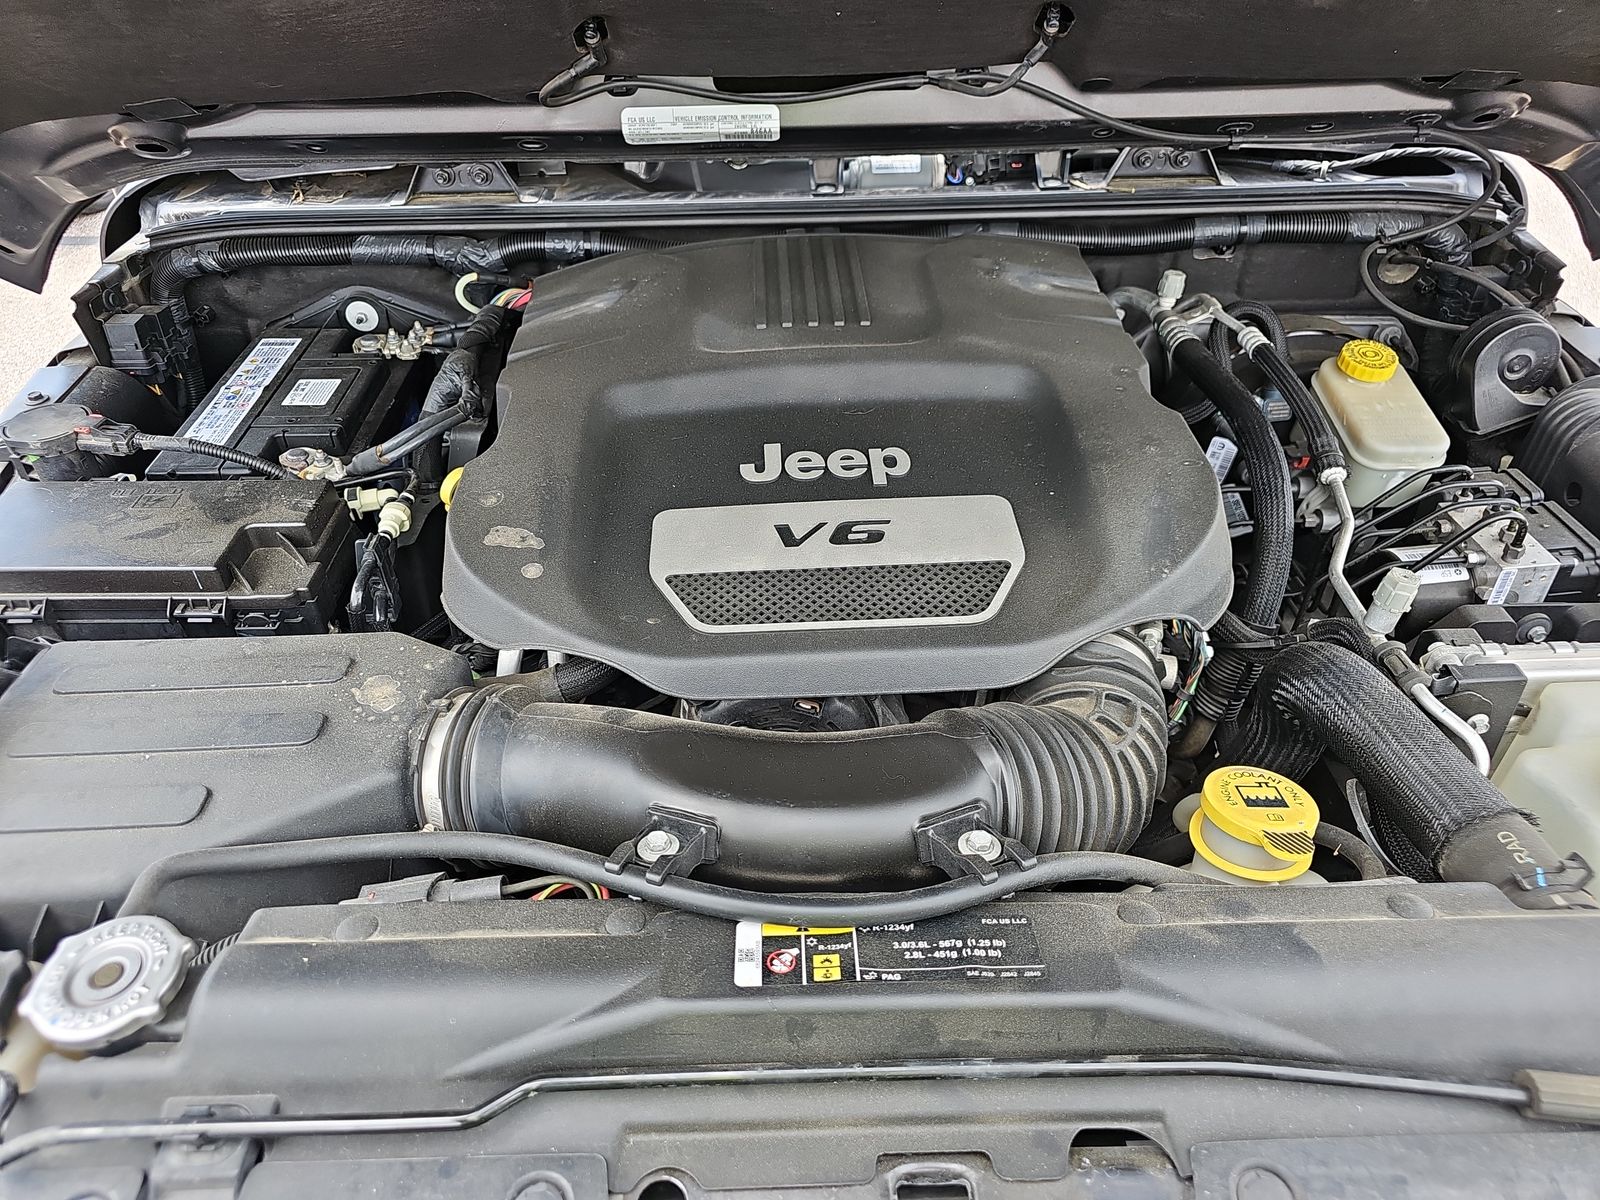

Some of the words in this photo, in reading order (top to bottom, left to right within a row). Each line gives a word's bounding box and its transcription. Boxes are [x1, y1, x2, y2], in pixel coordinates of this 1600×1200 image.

[739, 442, 912, 487] Jeep
[773, 519, 892, 548] V6
[1227, 771, 1282, 785] COOLANT
[1219, 779, 1238, 806] ENGINE
[1284, 786, 1305, 807] ONLY
[1496, 831, 1537, 864] RAD
[818, 942, 852, 951] R-1234yf
[892, 940, 931, 949] 3.0/3.6L
[938, 939, 963, 948] 567g
[967, 938, 991, 947] (1.25
[993, 938, 1006, 948] lb)
[904, 951, 926, 959] 2.8L
[933, 950, 958, 959] 451g
[962, 949, 986, 957] (1.00
[988, 949, 1002, 958] lb)
[881, 973, 902, 981] PAG
